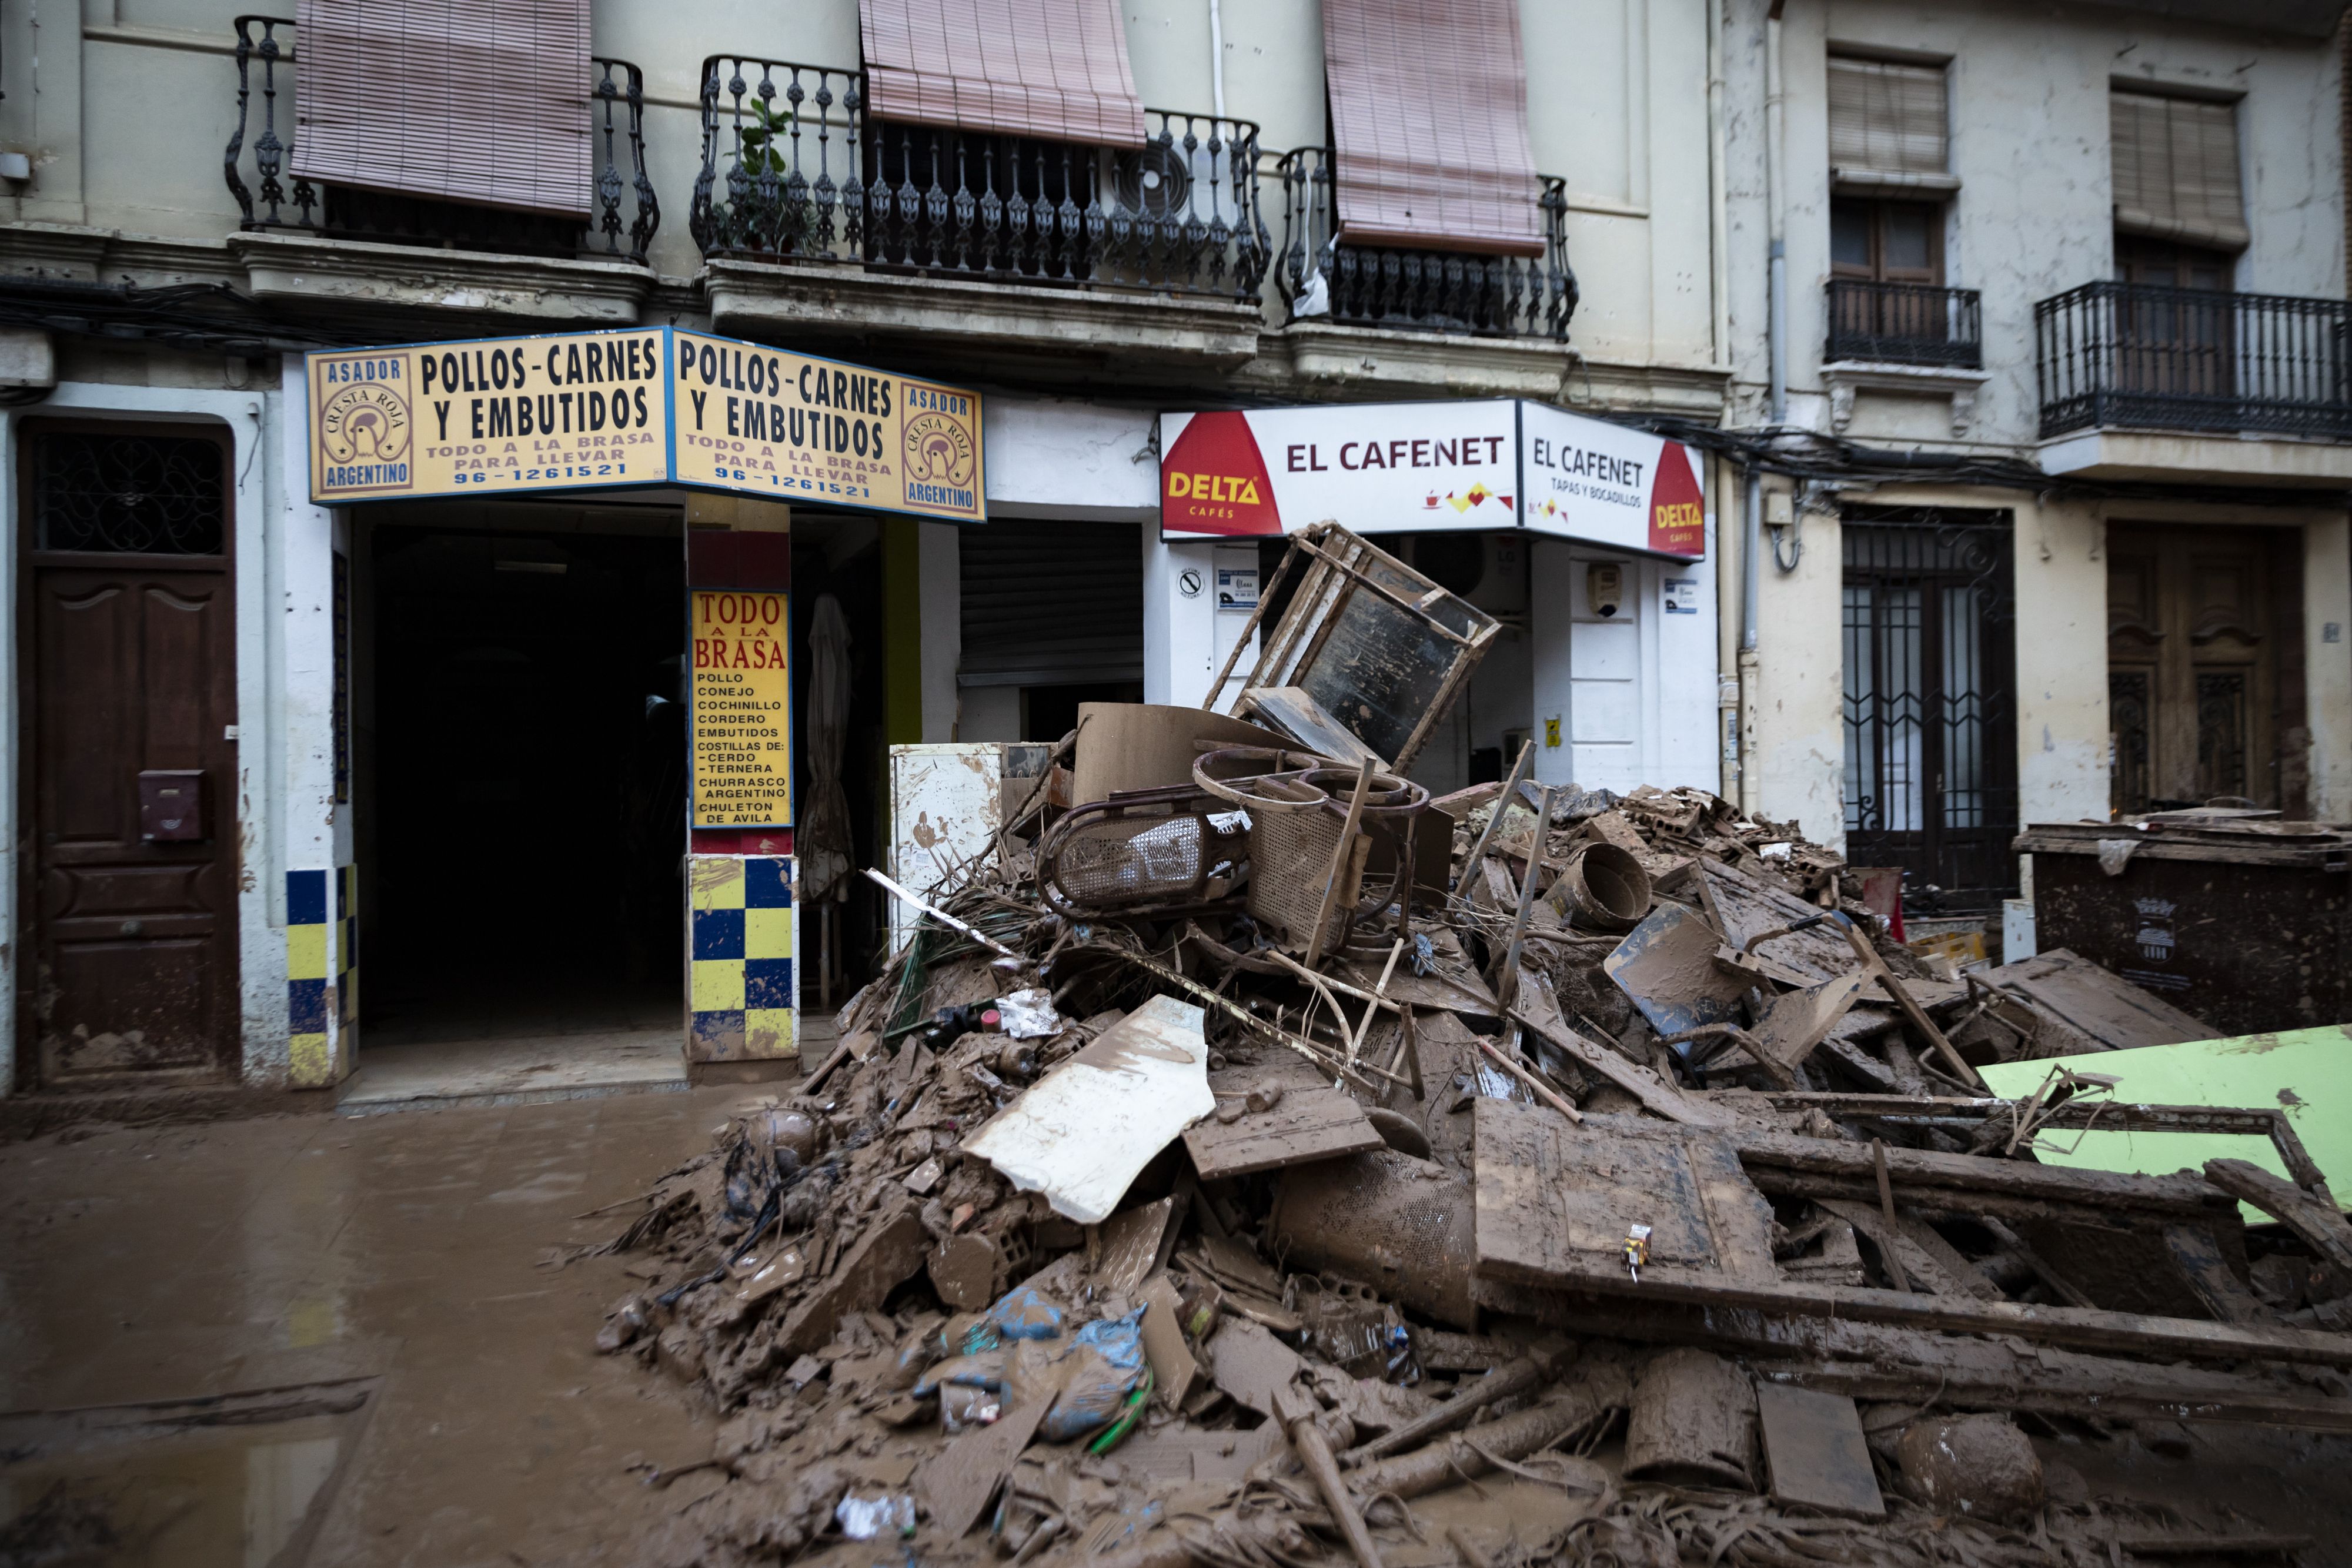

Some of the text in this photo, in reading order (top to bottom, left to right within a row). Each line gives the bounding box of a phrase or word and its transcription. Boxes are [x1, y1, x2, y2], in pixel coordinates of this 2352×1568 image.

[329, 359, 400, 383] ASADOR
[328, 390, 405, 433] CRESTA ROJA
[434, 386, 648, 440] Y EMBUTIDOS
[910, 388, 967, 416] ASADOR
[690, 389, 883, 460] Y EMBUTIDOS
[426, 432, 654, 458] TODO A LA BRASA
[908, 418, 970, 459] CRESTA ROJA
[455, 449, 624, 469] PARA LLEVAR
[686, 434, 891, 476] TODO A LA BRASA
[1288, 436, 1505, 472] EL CAFENET
[1535, 437, 1643, 487] EL CAFENET
[327, 463, 407, 486] ARGENTINO
[714, 453, 867, 484] PARA LLEVAR
[909, 482, 973, 508] ARGENTINO
[1168, 472, 1260, 504] DELTA
[1552, 478, 1641, 508] TAPAS Y BOCADILLOS
[1190, 507, 1234, 519] CAFÉS
[1655, 503, 1703, 529] DELTA
[1498, 550, 1515, 563] LG
[700, 594, 780, 624] TODO
[711, 627, 769, 637] A LA
[695, 638, 786, 668] BRASA
[697, 674, 743, 683] POLLO
[698, 687, 754, 696] CONEJO
[698, 701, 781, 710] COCHINILLO
[698, 715, 765, 723] CORDERO
[698, 728, 778, 737] EMBUTIDOS
[698, 743, 784, 751] COSTILLAS DE:
[699, 778, 785, 787] CHURRASCO
[706, 789, 786, 797] ARGENTINO
[700, 803, 773, 811] CHULETON
[733, 814, 771, 823] AVILA
